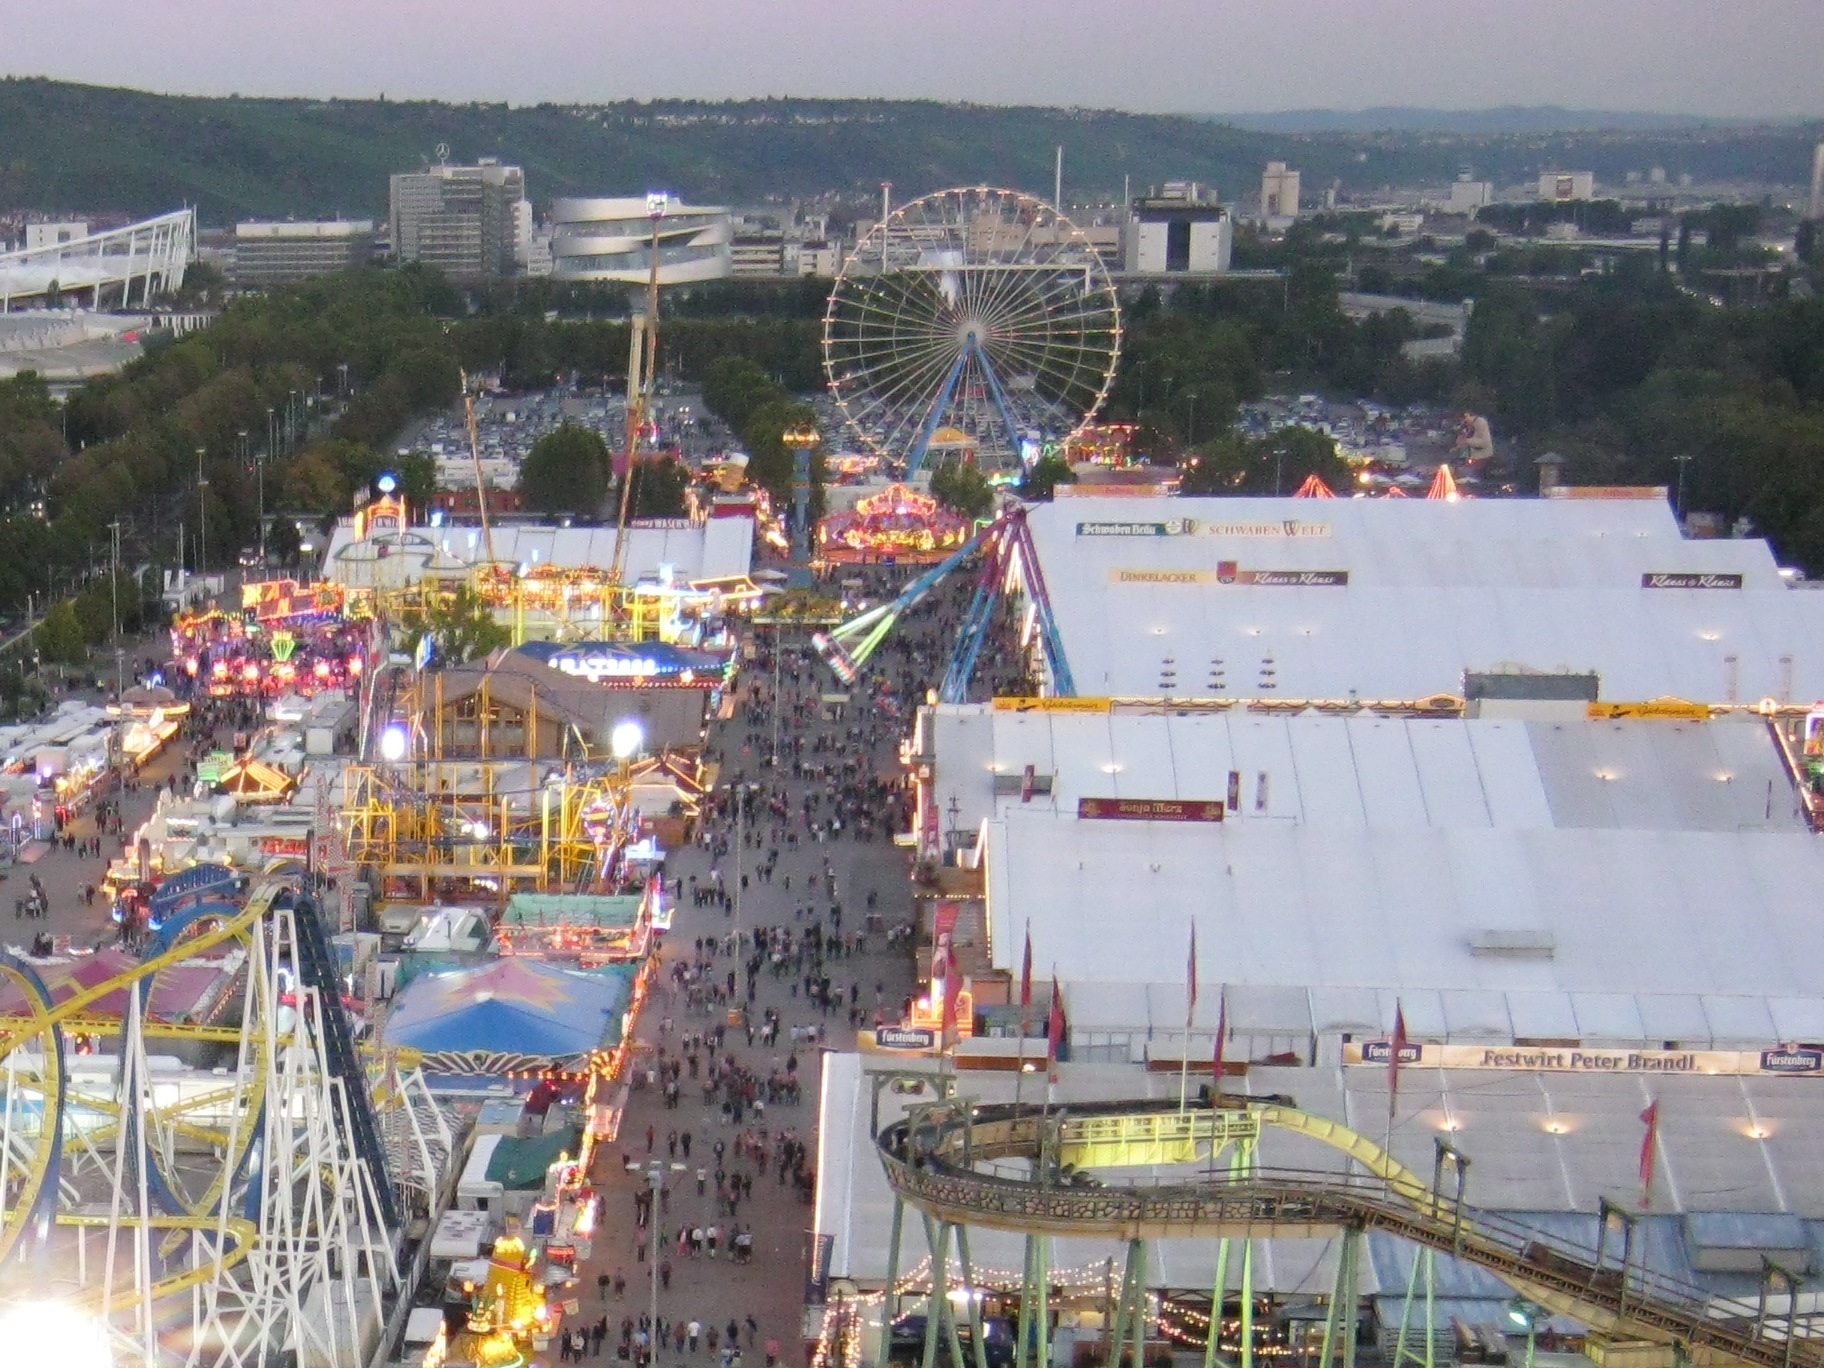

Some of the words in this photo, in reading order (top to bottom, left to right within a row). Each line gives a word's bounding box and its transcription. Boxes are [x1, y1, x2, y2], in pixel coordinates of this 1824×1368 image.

[1082, 522, 1131, 536] Schwaben
[1208, 524, 1280, 536] SCHWABEN
[1120, 571, 1197, 584] DINKELACKER
[882, 1029, 929, 1046] Fürstenberg
[1483, 1050, 1564, 1067] Festwirt
[1570, 1052, 1623, 1069] Peter
[1766, 1053, 1817, 1068] Fürstenberg
